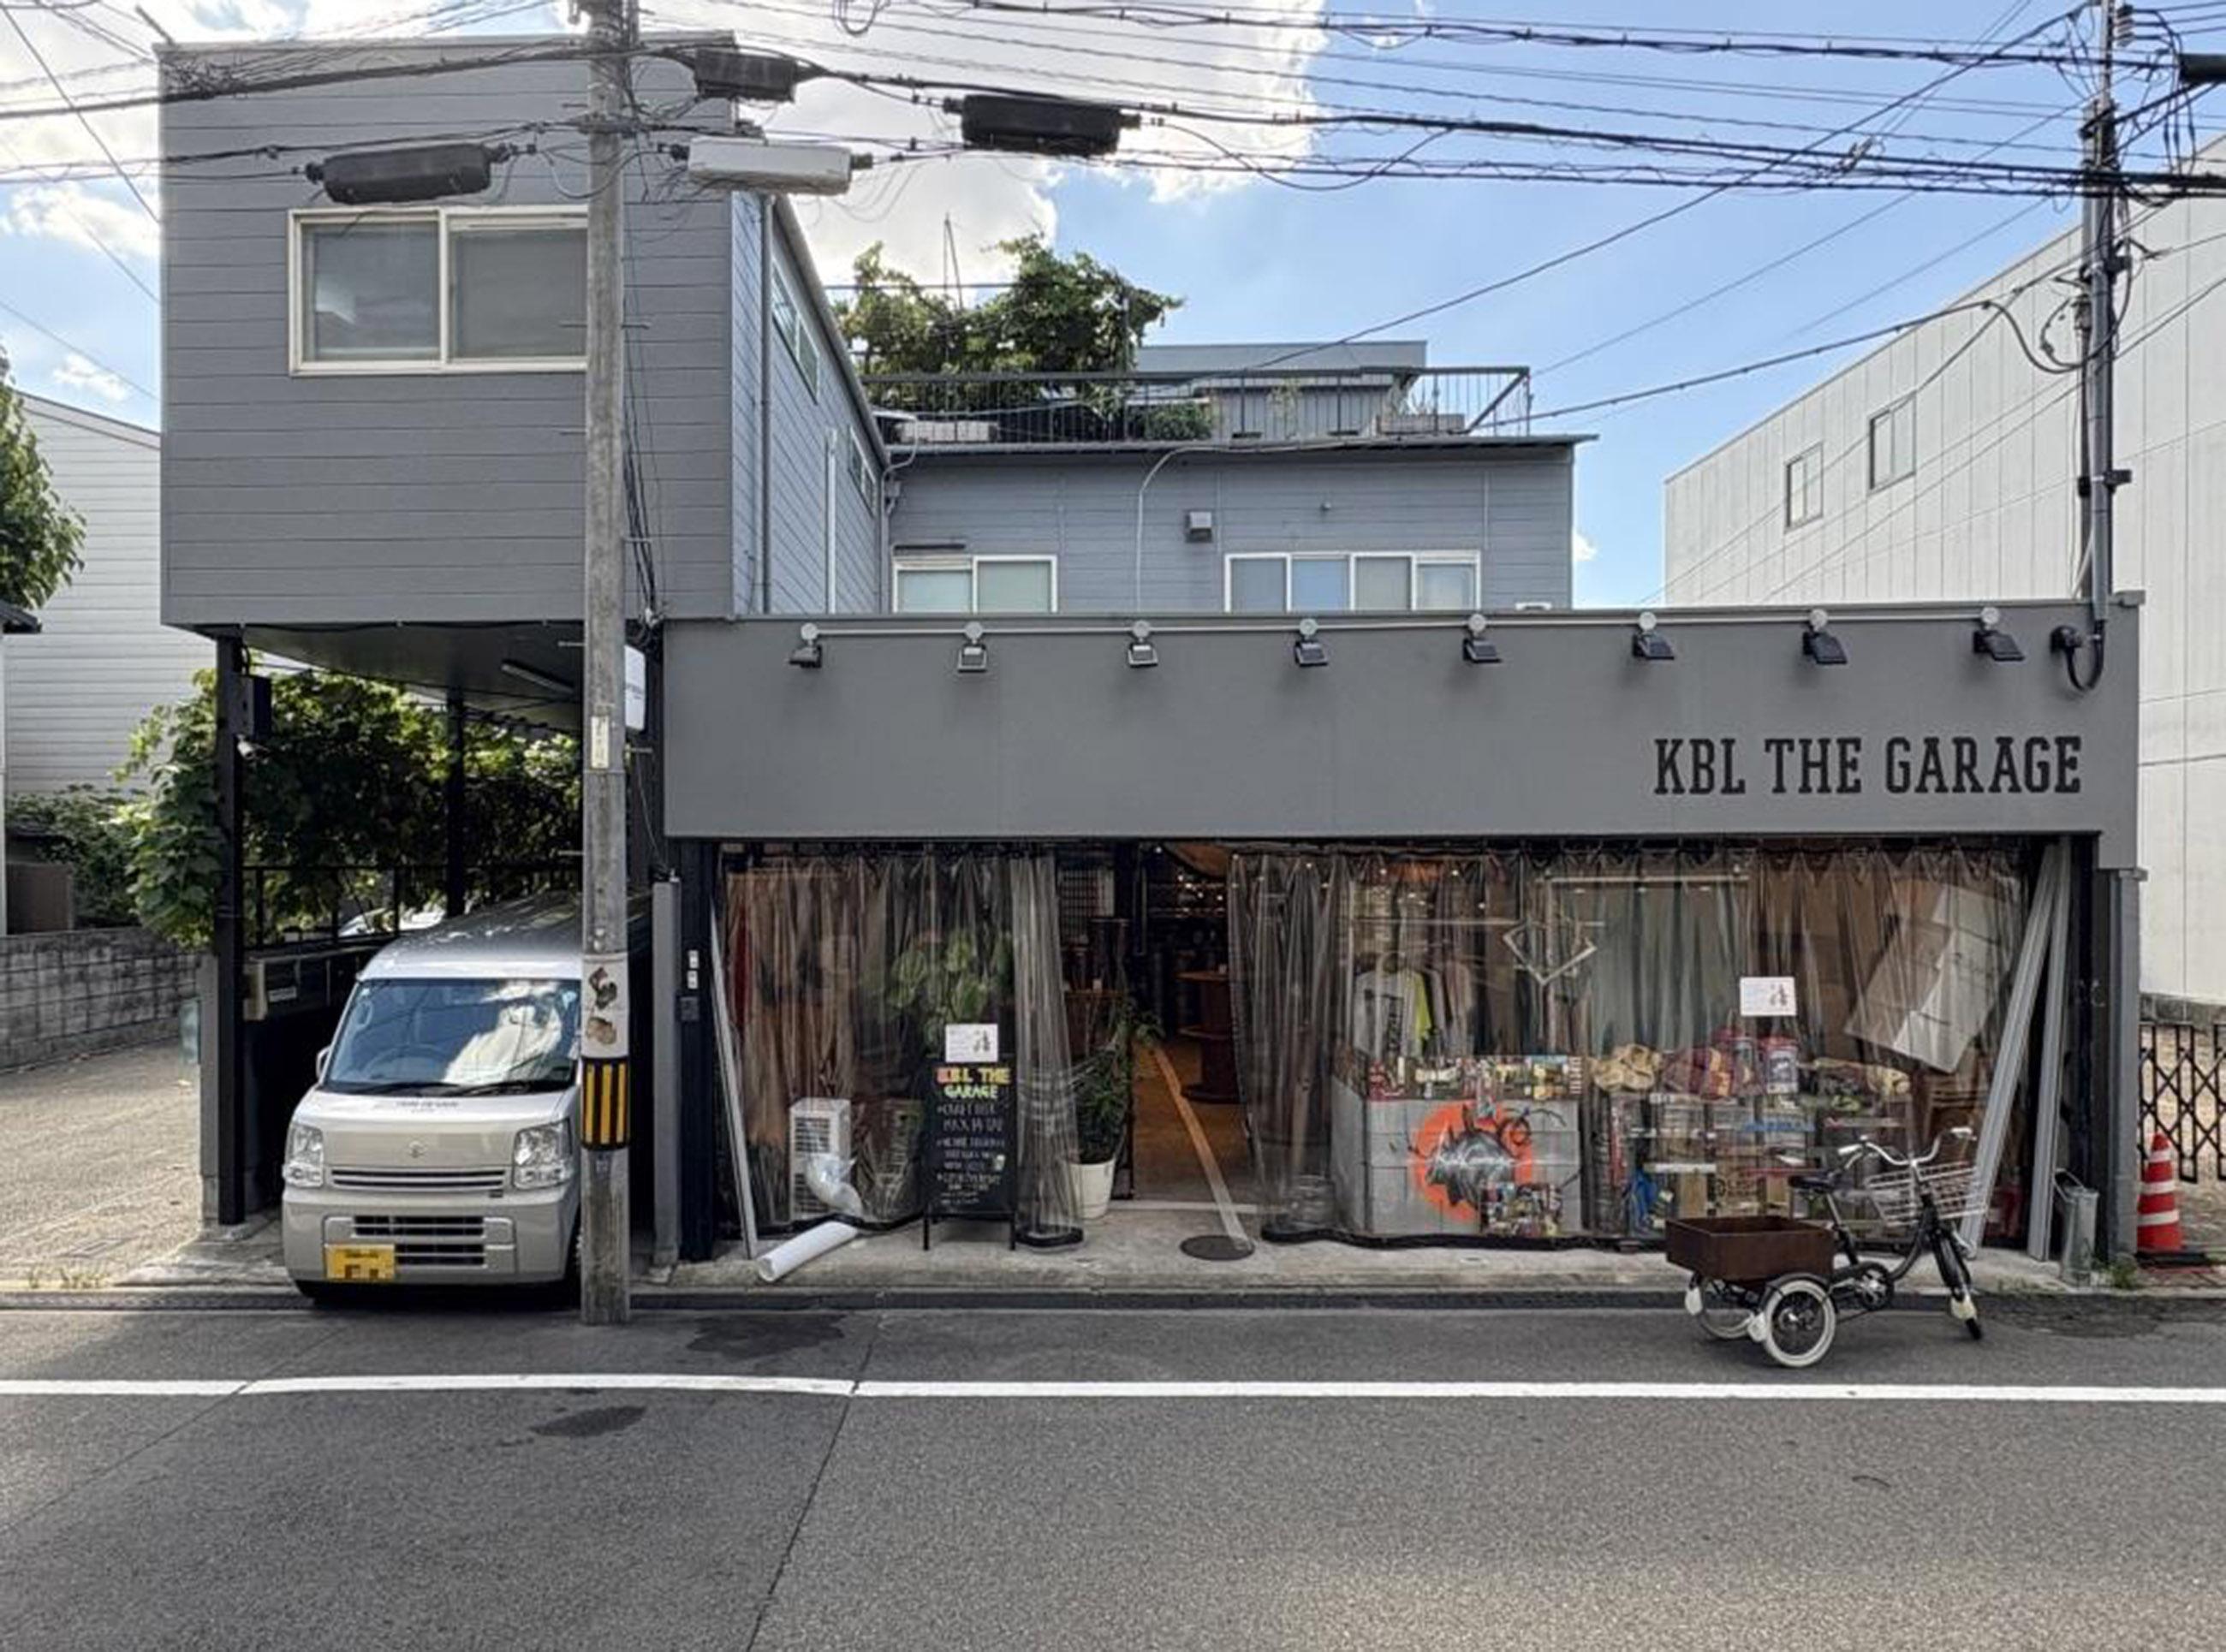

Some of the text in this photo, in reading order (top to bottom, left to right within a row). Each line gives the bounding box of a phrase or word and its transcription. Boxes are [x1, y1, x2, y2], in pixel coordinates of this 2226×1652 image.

[1654, 735, 2082, 795] KBL THE GARAGE
[977, 1067, 1011, 1084] THE
[943, 1084, 999, 1099] GARAGE
